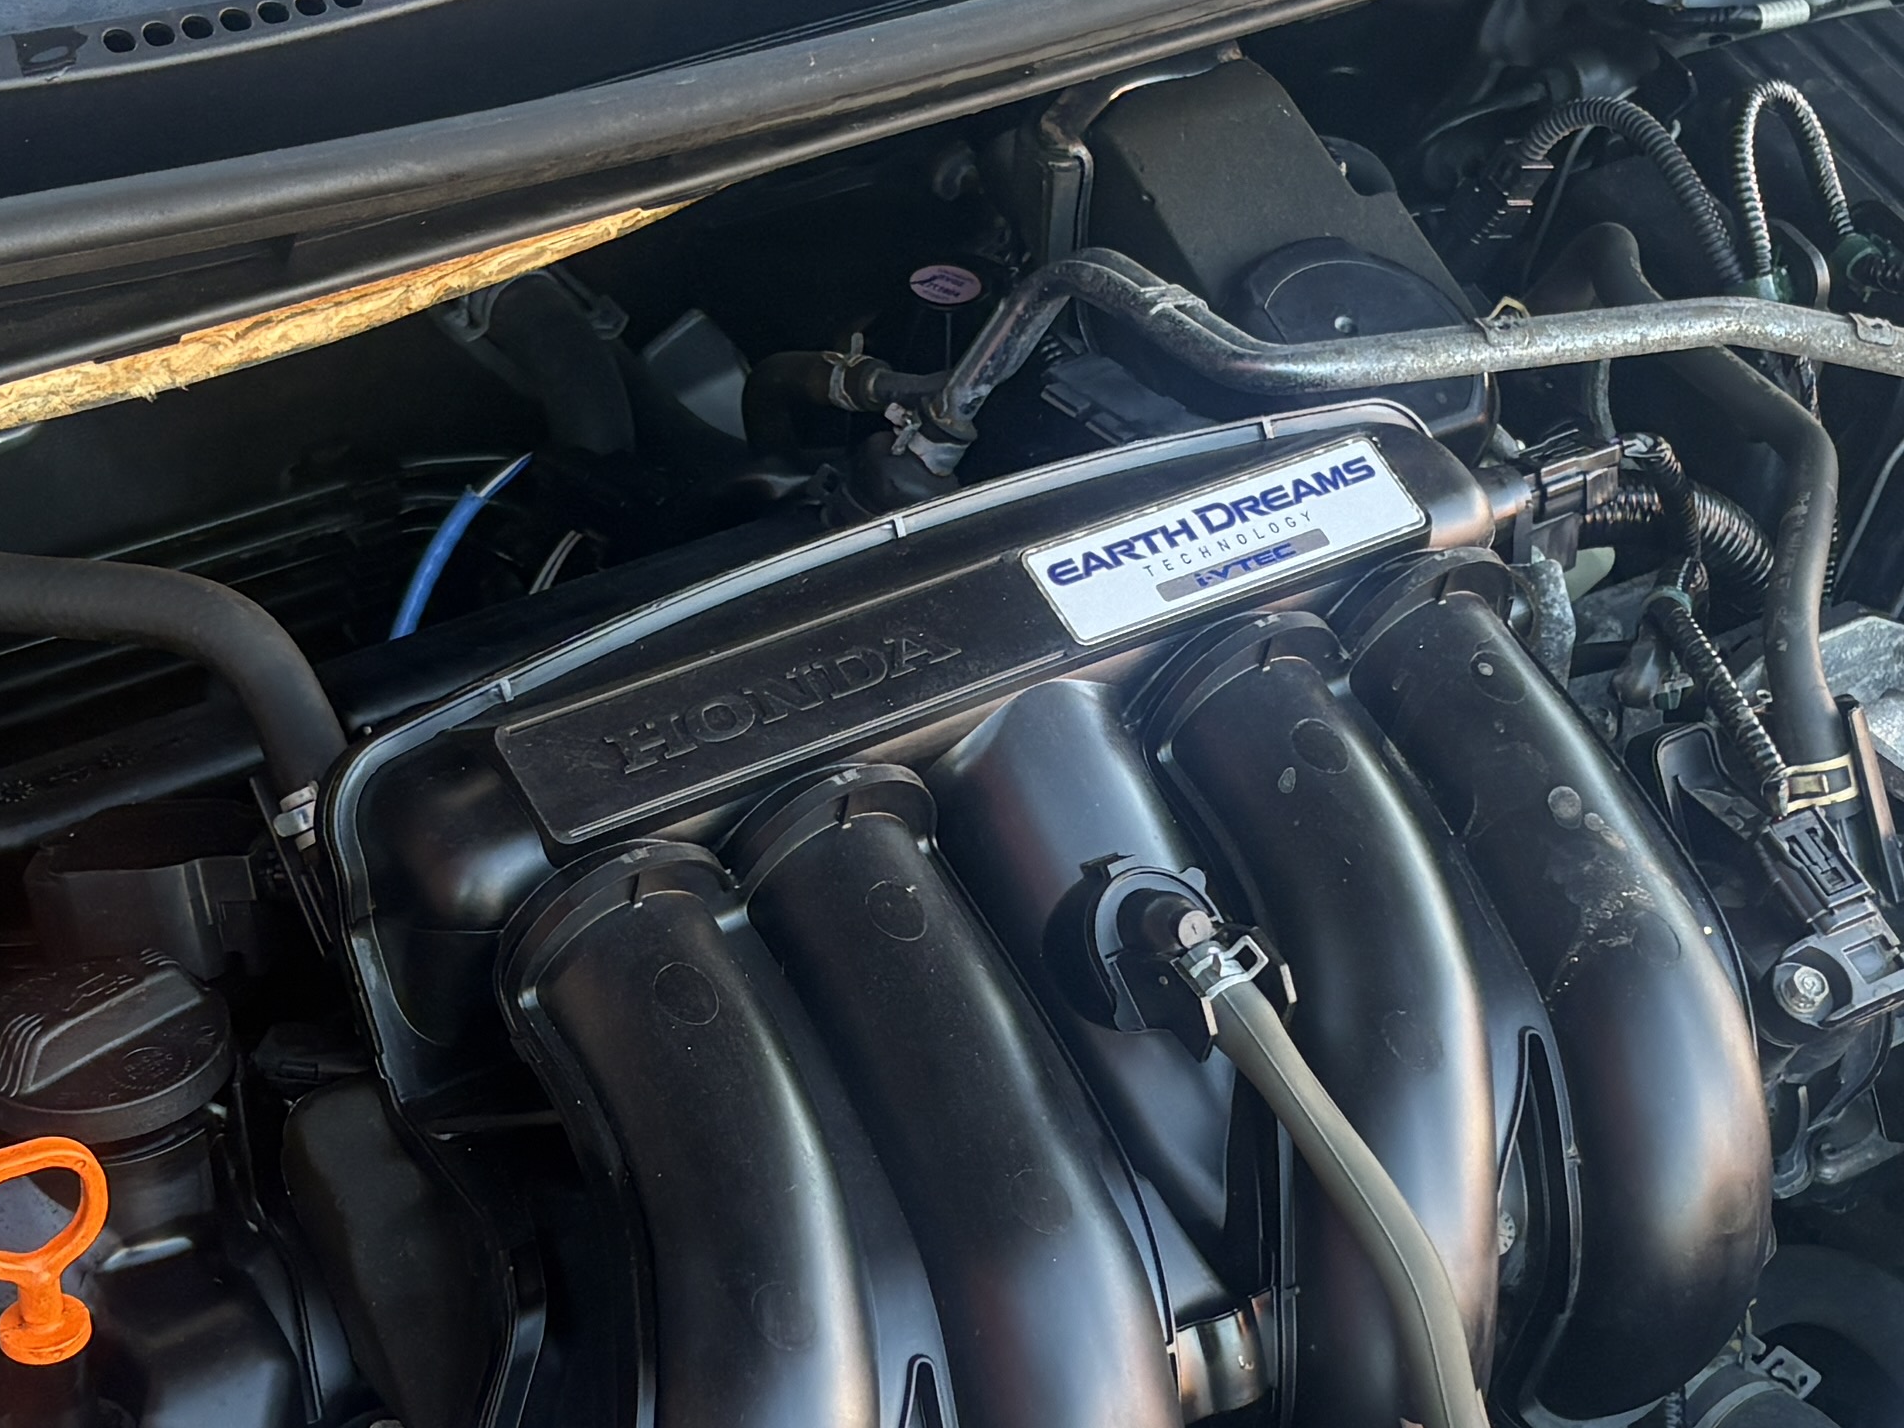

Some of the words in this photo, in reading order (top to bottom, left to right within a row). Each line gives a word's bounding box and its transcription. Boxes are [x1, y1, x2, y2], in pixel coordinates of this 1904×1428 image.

[1046, 518, 1198, 587] EARTH
[1141, 509, 1314, 579] TECHNOLOGY
[1195, 541, 1298, 588] i-VTEC
[603, 627, 963, 776] HONDA
